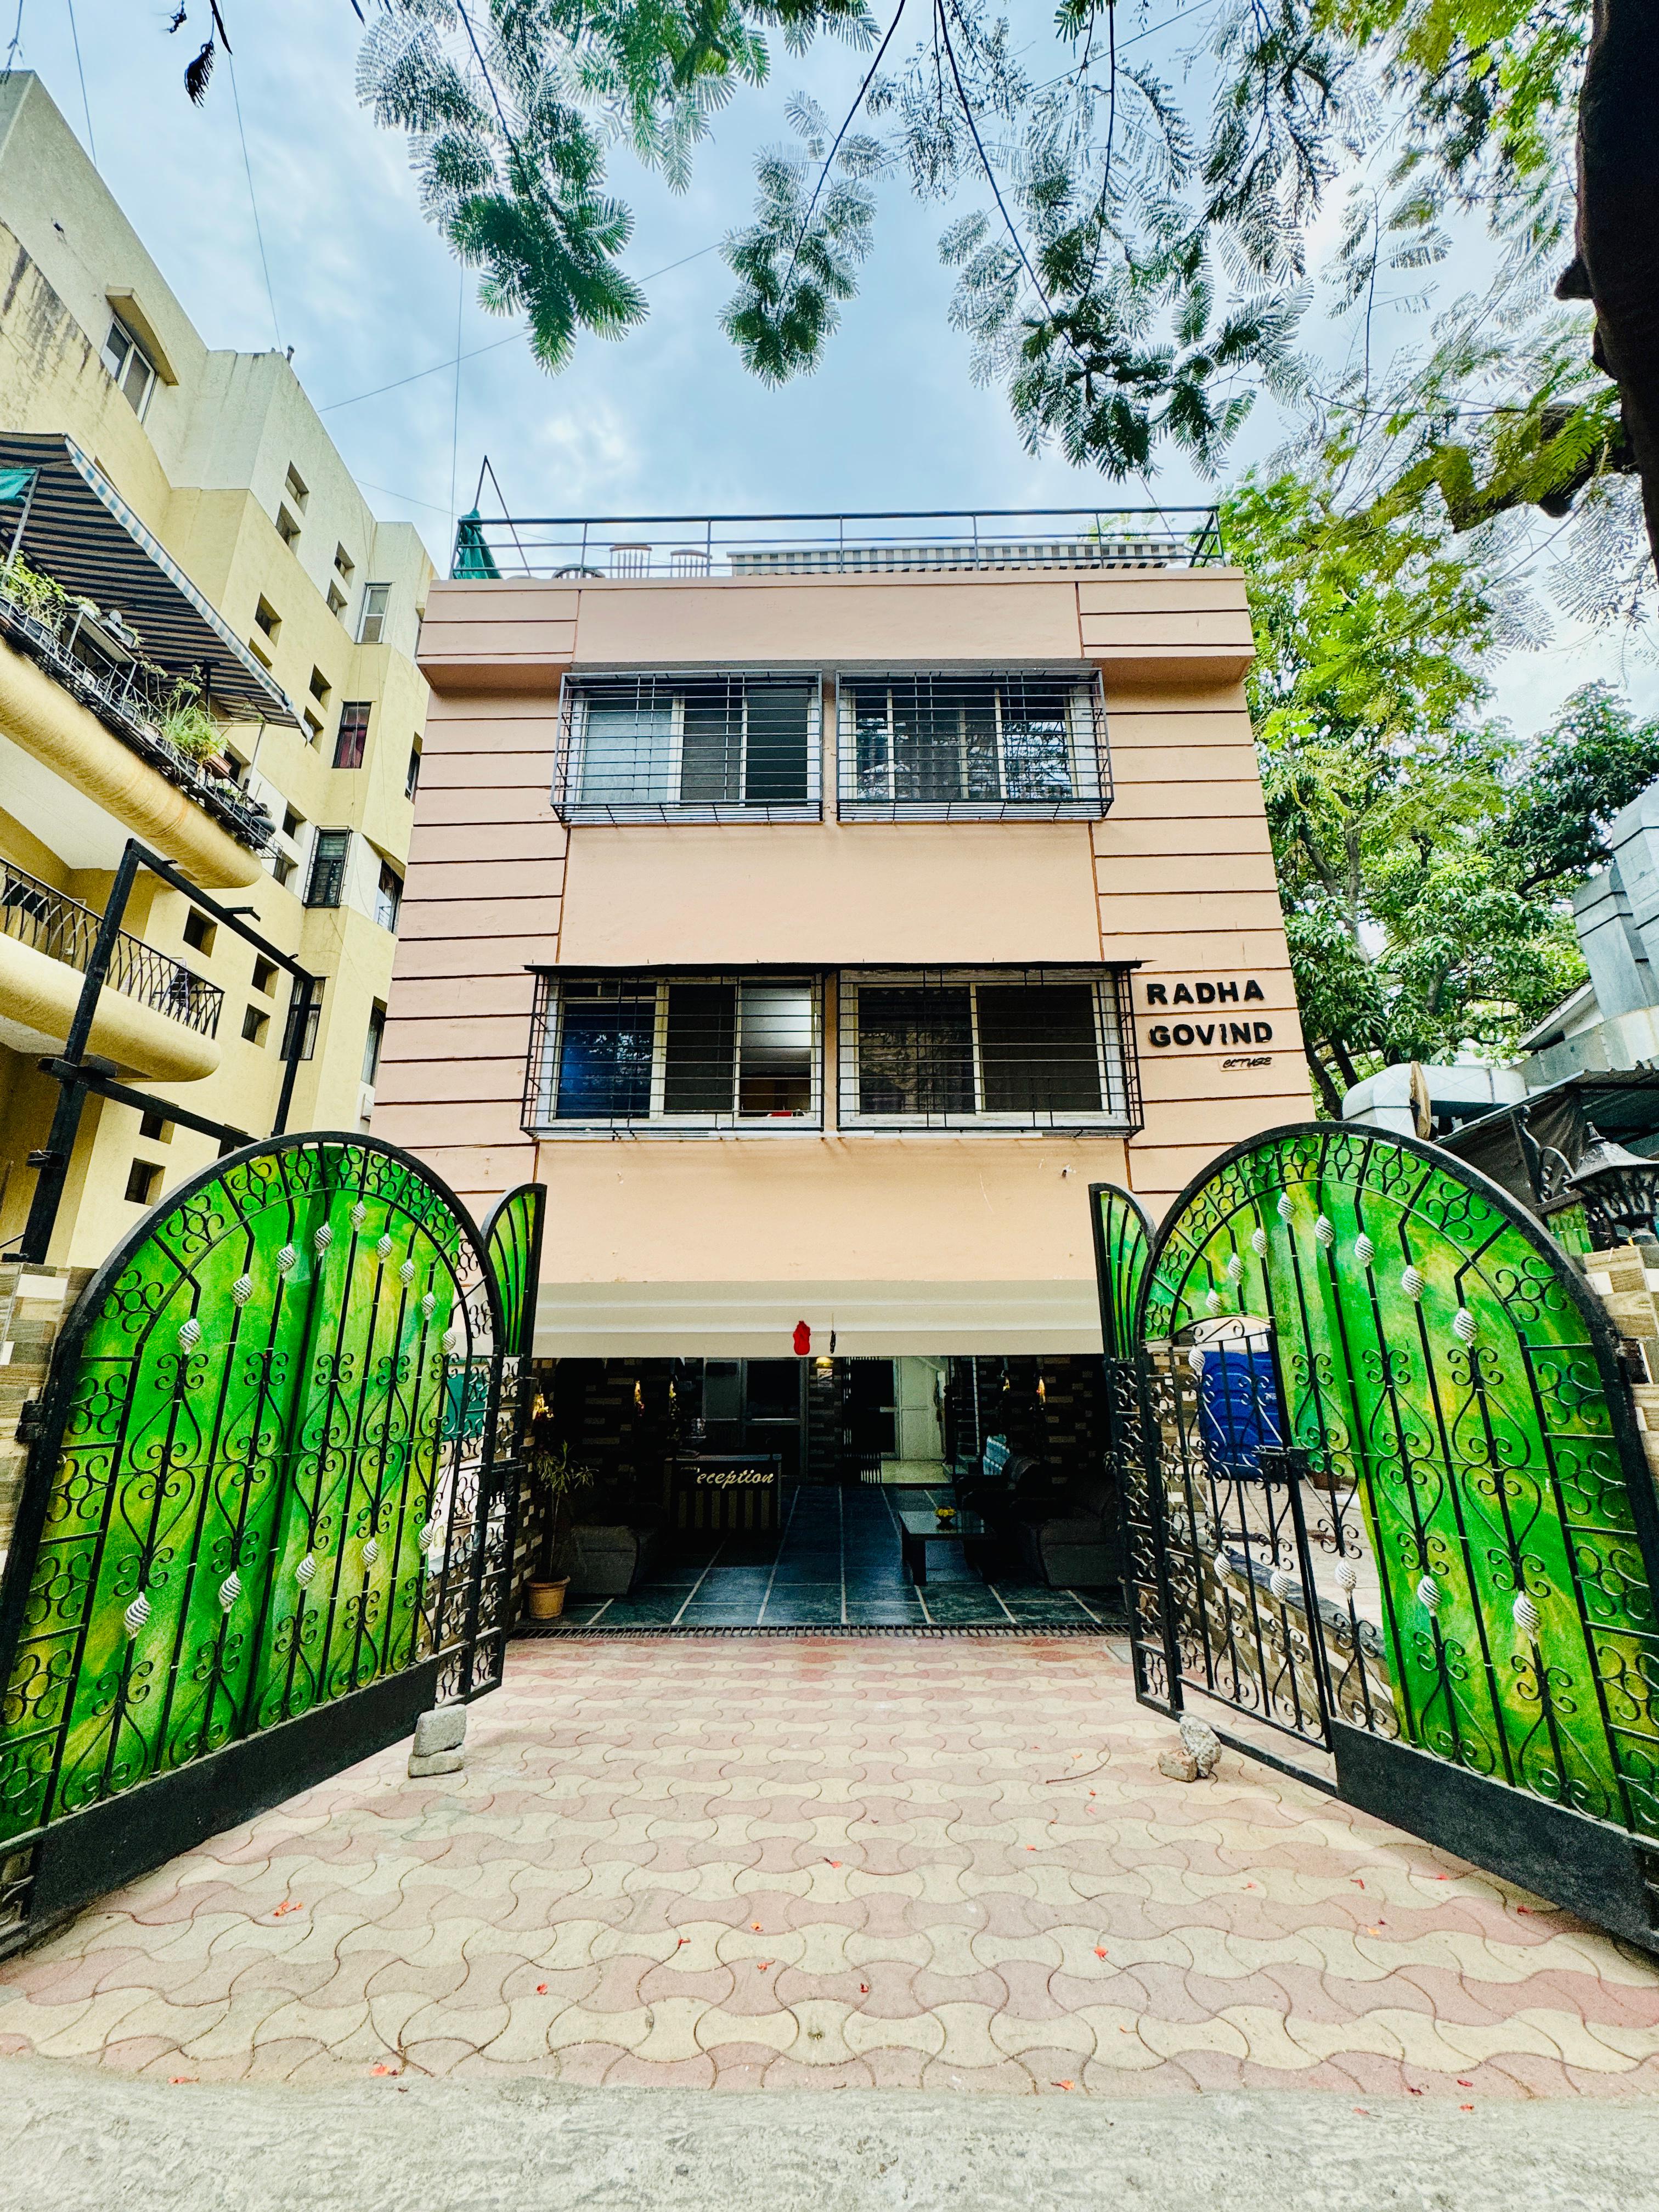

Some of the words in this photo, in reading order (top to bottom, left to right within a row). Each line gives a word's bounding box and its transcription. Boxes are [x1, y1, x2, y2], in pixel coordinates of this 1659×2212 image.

[1146, 979, 1265, 1005] RADHA
[1148, 1022, 1273, 1048] GOVIND
[681, 1466, 775, 1489] eception
